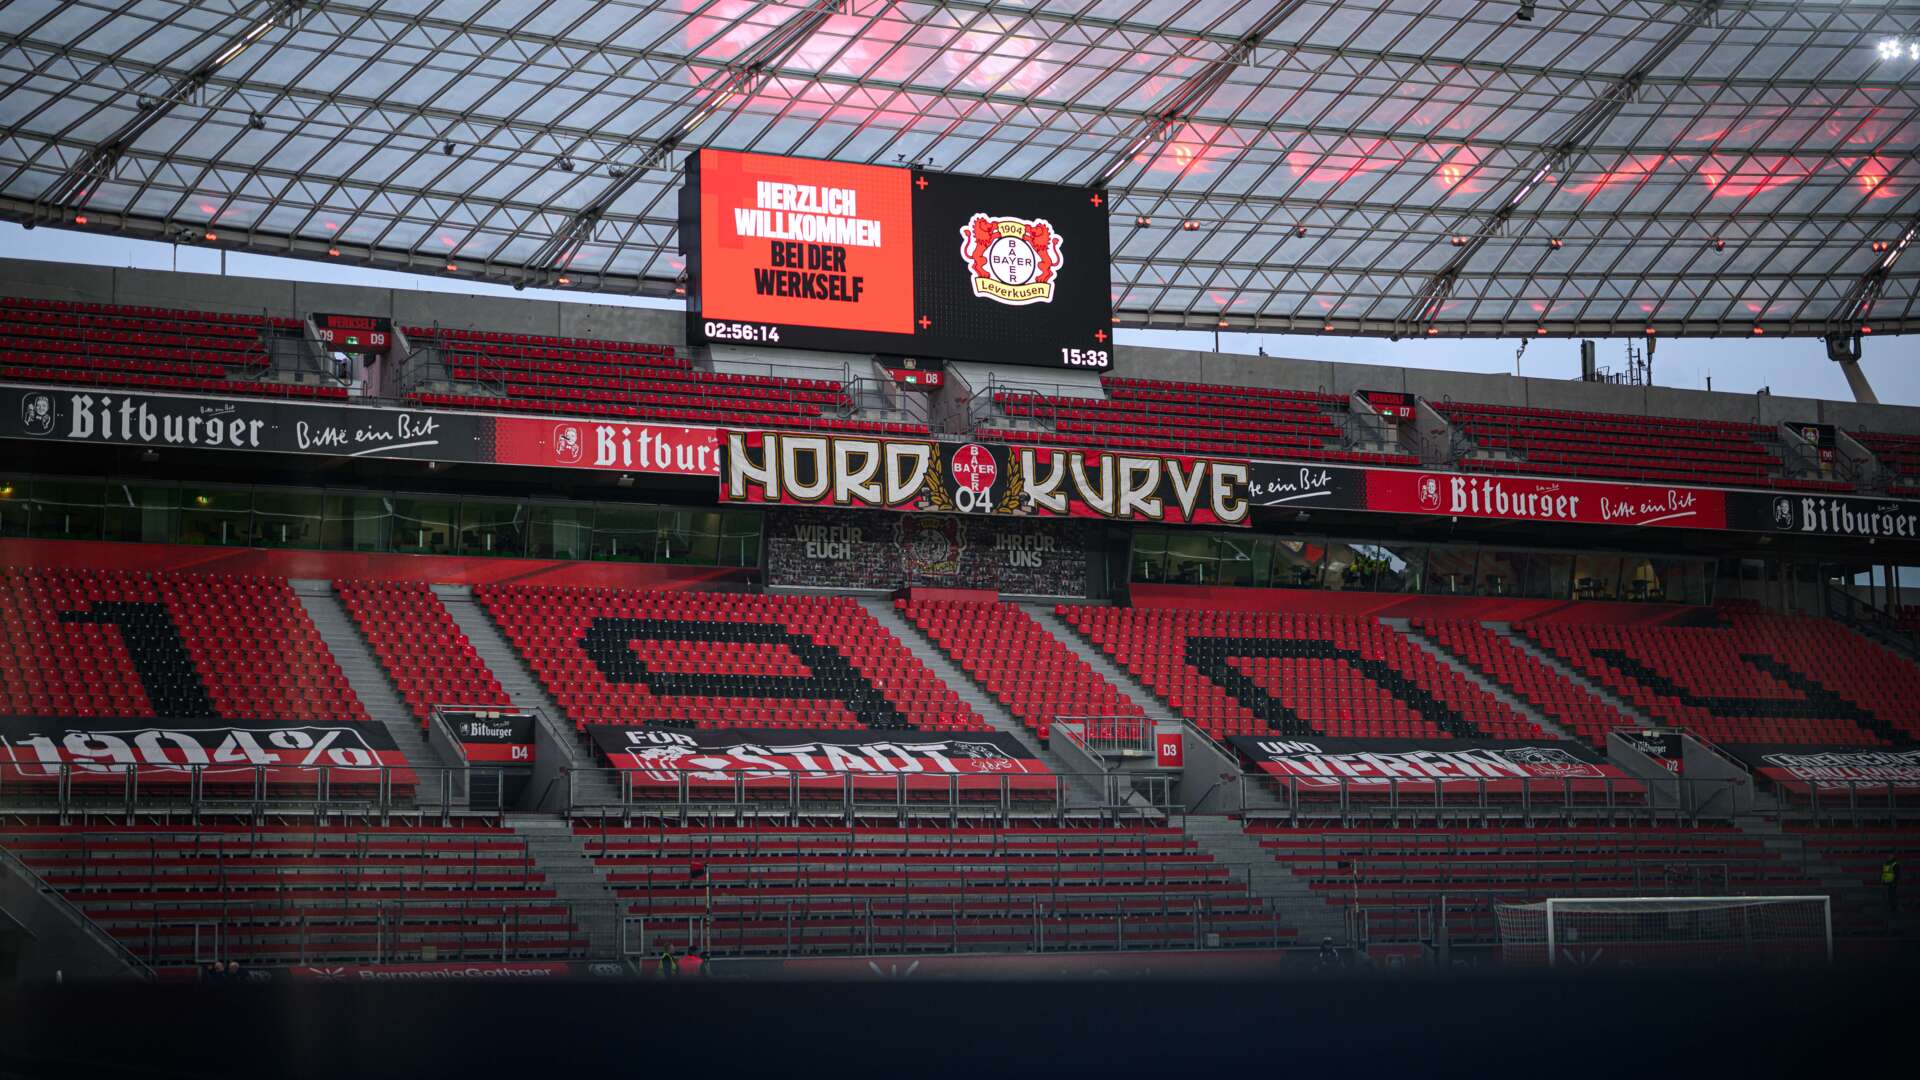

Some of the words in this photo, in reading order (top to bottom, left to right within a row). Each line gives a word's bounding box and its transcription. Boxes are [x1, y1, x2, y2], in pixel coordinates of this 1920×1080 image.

[757, 180, 856, 217] HERZLICH
[734, 207, 881, 248] WILLKOMMEN
[1000, 225, 1023, 235] 1904
[771, 241, 804, 269] BEI
[808, 244, 846, 272] DER
[993, 255, 1032, 266] BAYER
[1008, 240, 1017, 282] BAYER
[754, 268, 864, 303] WERKSELF
[981, 281, 1045, 298] Leverkusen
[370, 333, 384, 345] D9
[704, 321, 780, 343] 02:56:14
[1061, 348, 1108, 367] 15:33
[926, 373, 938, 384] D8
[67, 394, 264, 447] Bitburger
[297, 421, 348, 449] Bitte
[354, 425, 393, 442] ein
[398, 414, 440, 439] Bit
[729, 432, 932, 506] NORD
[954, 462, 994, 474] BAYER
[1268, 477, 1297, 493] ein
[1300, 467, 1332, 490] Bit
[1019, 448, 1249, 523] KURVE
[955, 486, 993, 513] 04
[1450, 477, 1579, 519] Bitburger
[1601, 496, 1636, 520] Bitte
[1640, 500, 1666, 513] ein
[1668, 489, 1696, 511] Bit
[1801, 498, 1917, 536] Bitburger
[795, 524, 829, 543] WIR
[830, 522, 863, 544] FÜR
[1024, 530, 1057, 552] FÜR
[806, 541, 850, 559] EUCH
[1009, 550, 1042, 567] UNS
[471, 722, 512, 739] Bitburger
[625, 731, 698, 746] FÜR
[16, 730, 372, 774] 1904%
[511, 746, 528, 759] D4
[726, 743, 960, 776] STADT
[1163, 744, 1177, 756] D3
[1257, 741, 1322, 754] UND
[1270, 750, 1531, 784] VEREIN
